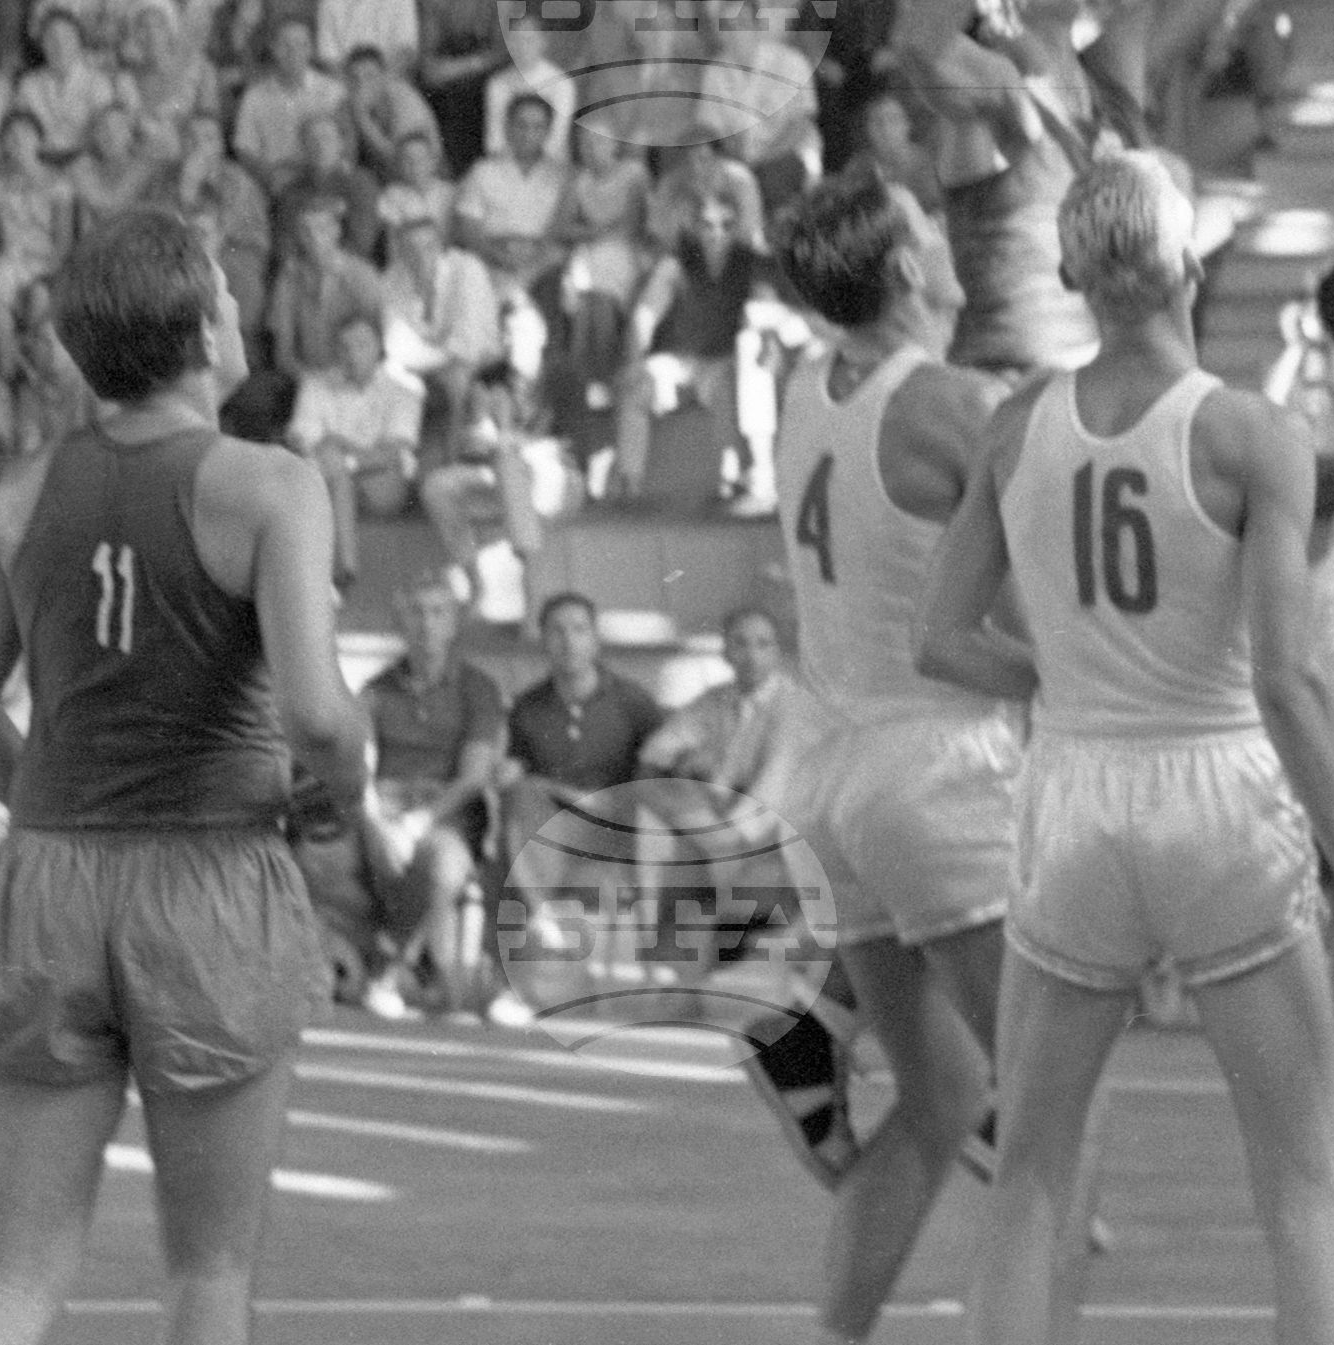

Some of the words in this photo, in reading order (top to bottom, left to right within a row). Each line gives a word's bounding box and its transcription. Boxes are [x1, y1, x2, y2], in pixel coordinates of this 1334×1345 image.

[796, 453, 835, 584] 4
[1073, 460, 1157, 615] 16
[92, 541, 134, 654] 11
